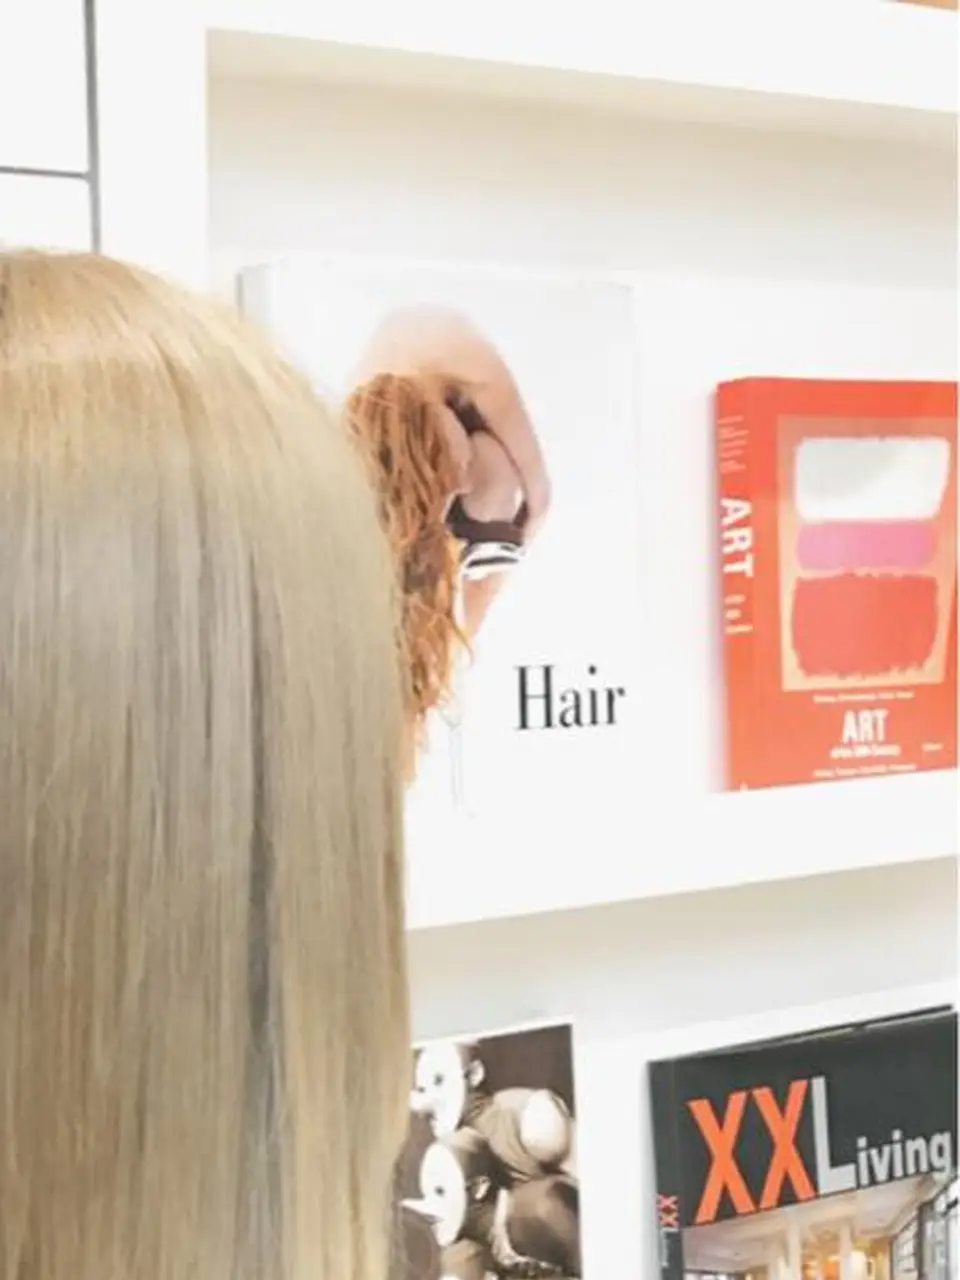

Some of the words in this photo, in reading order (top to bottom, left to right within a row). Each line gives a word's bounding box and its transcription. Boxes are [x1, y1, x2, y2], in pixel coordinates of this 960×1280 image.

[720, 498, 754, 578] ART
[514, 664, 626, 730] Hair
[842, 708, 888, 743] ART
